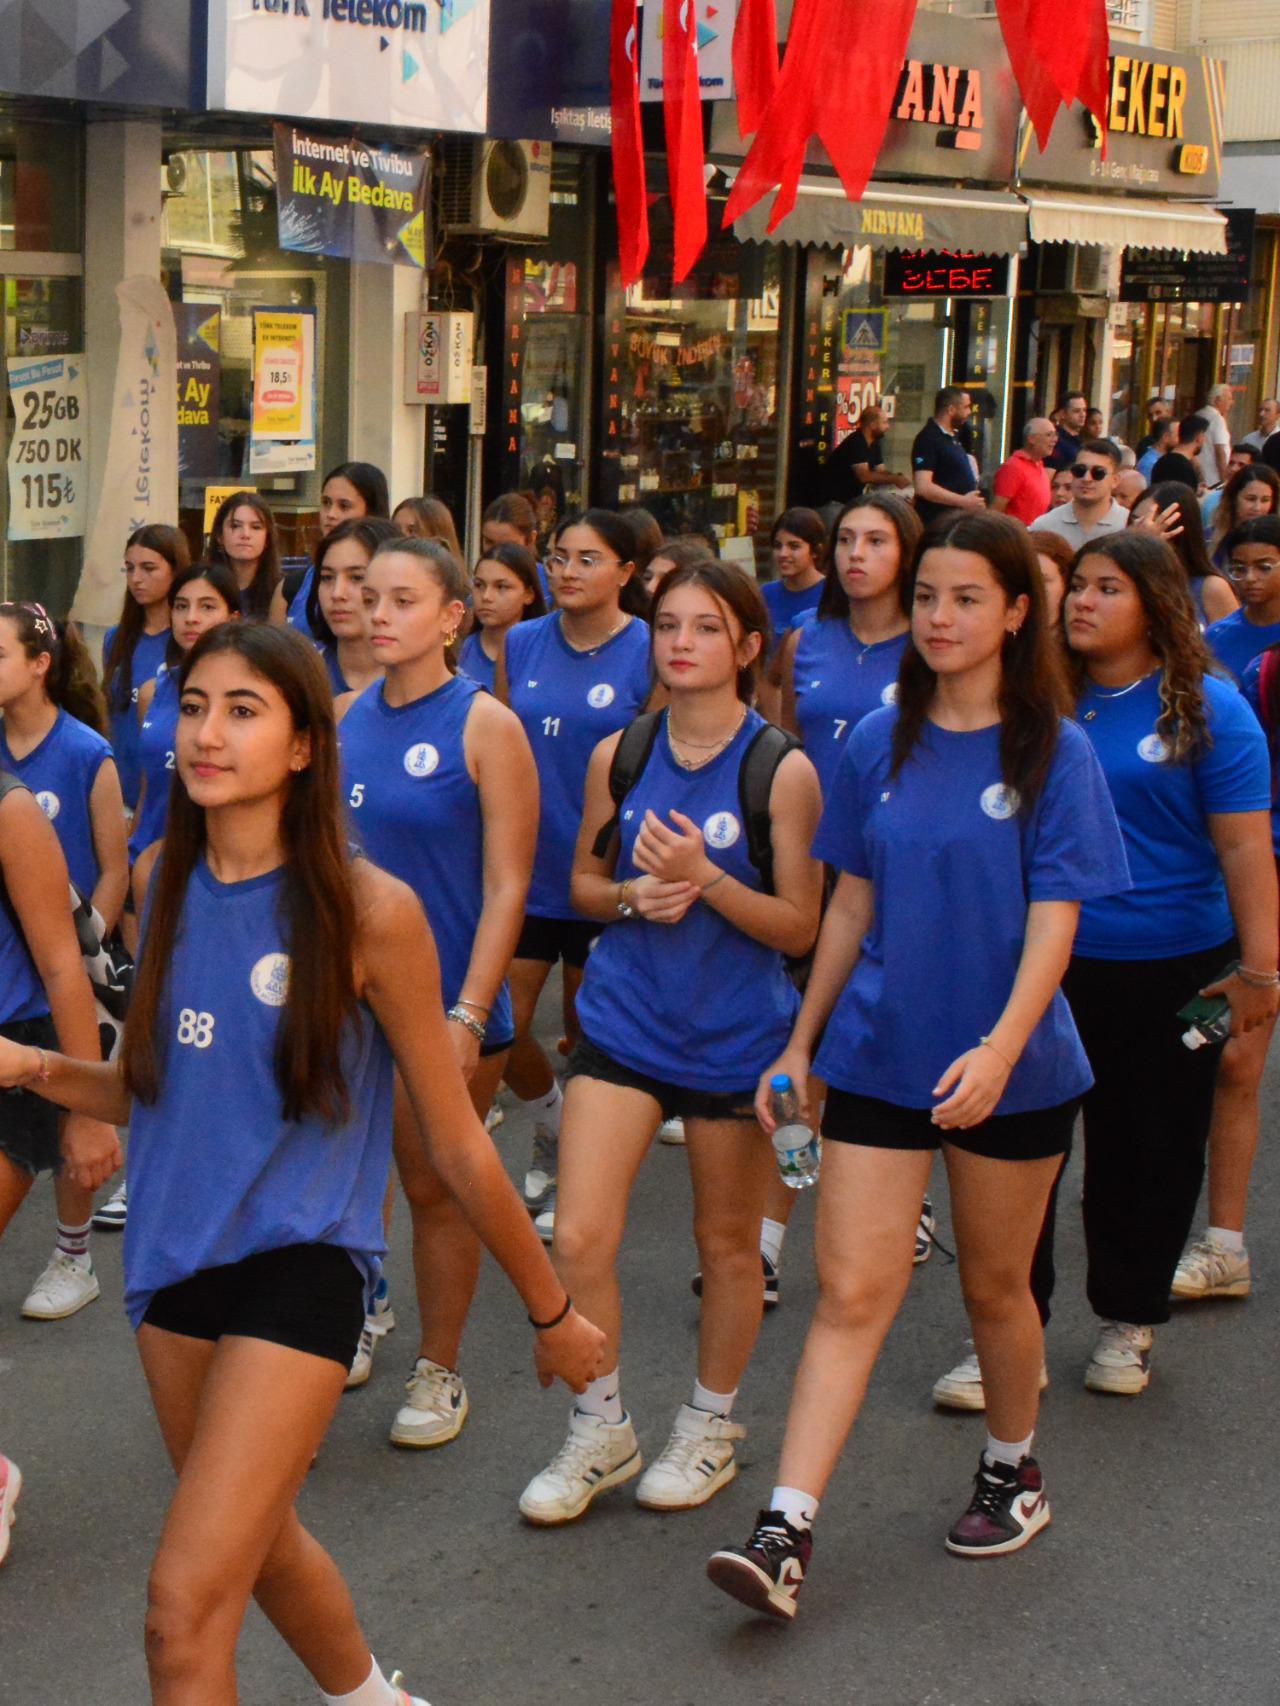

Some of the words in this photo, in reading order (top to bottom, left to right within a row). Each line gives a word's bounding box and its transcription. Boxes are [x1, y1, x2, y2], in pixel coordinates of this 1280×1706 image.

[1091, 55, 1188, 148] EKER
[292, 128, 350, 165] İnternet
[351, 149, 370, 168] ve
[371, 150, 414, 177] Tivibu
[292, 159, 317, 196] İlk
[319, 171, 345, 206] Ay
[347, 176, 414, 213] Bedava
[185, 377, 211, 407] Ay
[16, 440, 51, 464] 750
[56, 438, 82, 462] DK
[541, 716, 560, 736] 11
[833, 718, 848, 739] 7
[349, 783, 366, 808] 5
[177, 1007, 215, 1048] 88
